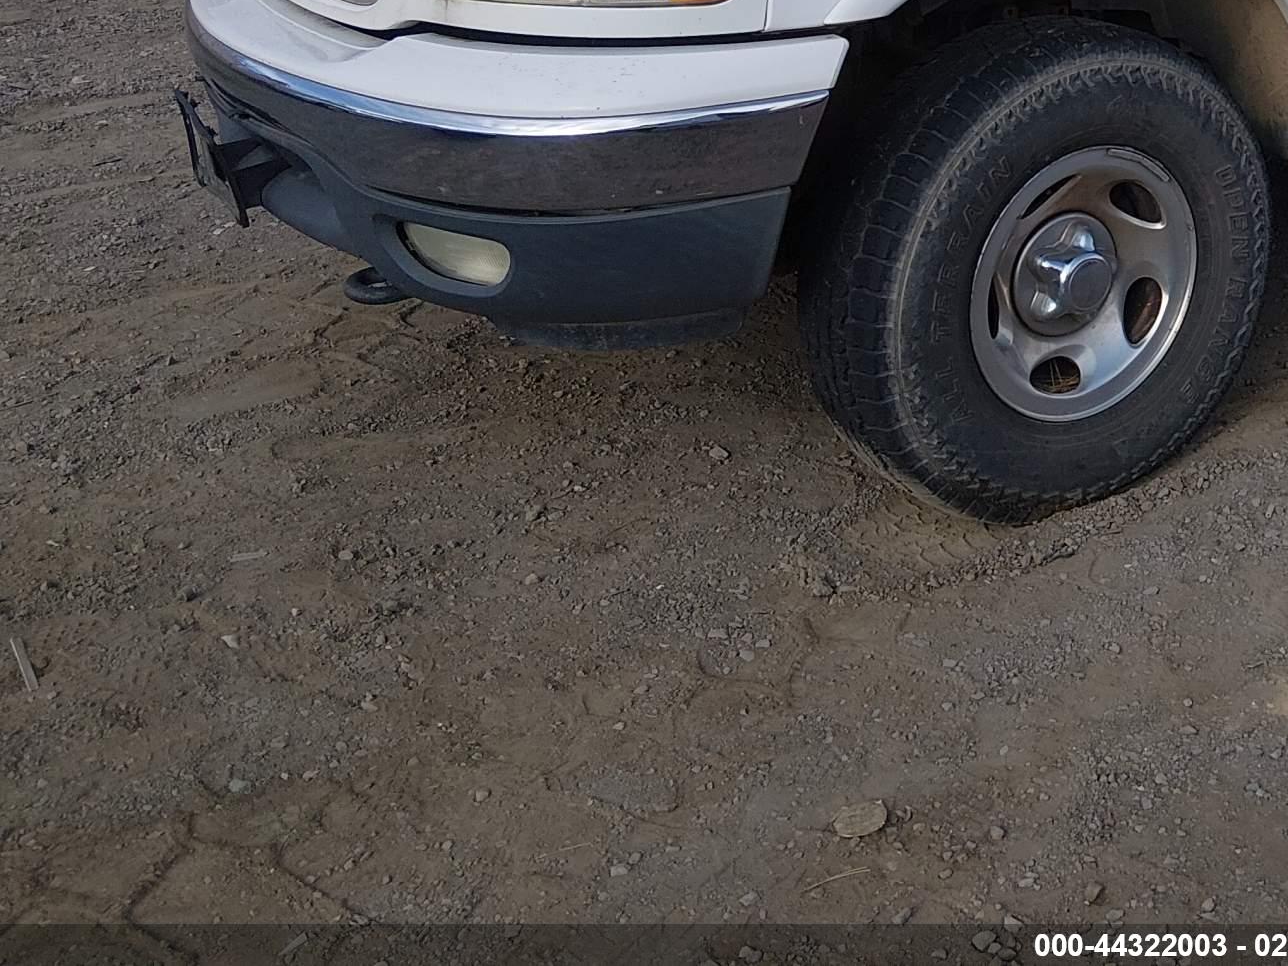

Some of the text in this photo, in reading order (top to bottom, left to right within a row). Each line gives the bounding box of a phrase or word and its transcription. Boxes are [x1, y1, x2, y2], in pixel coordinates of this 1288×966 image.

[929, 154, 1011, 425] ALL TERRAIN
[1213, 163, 1251, 262] OPEN
